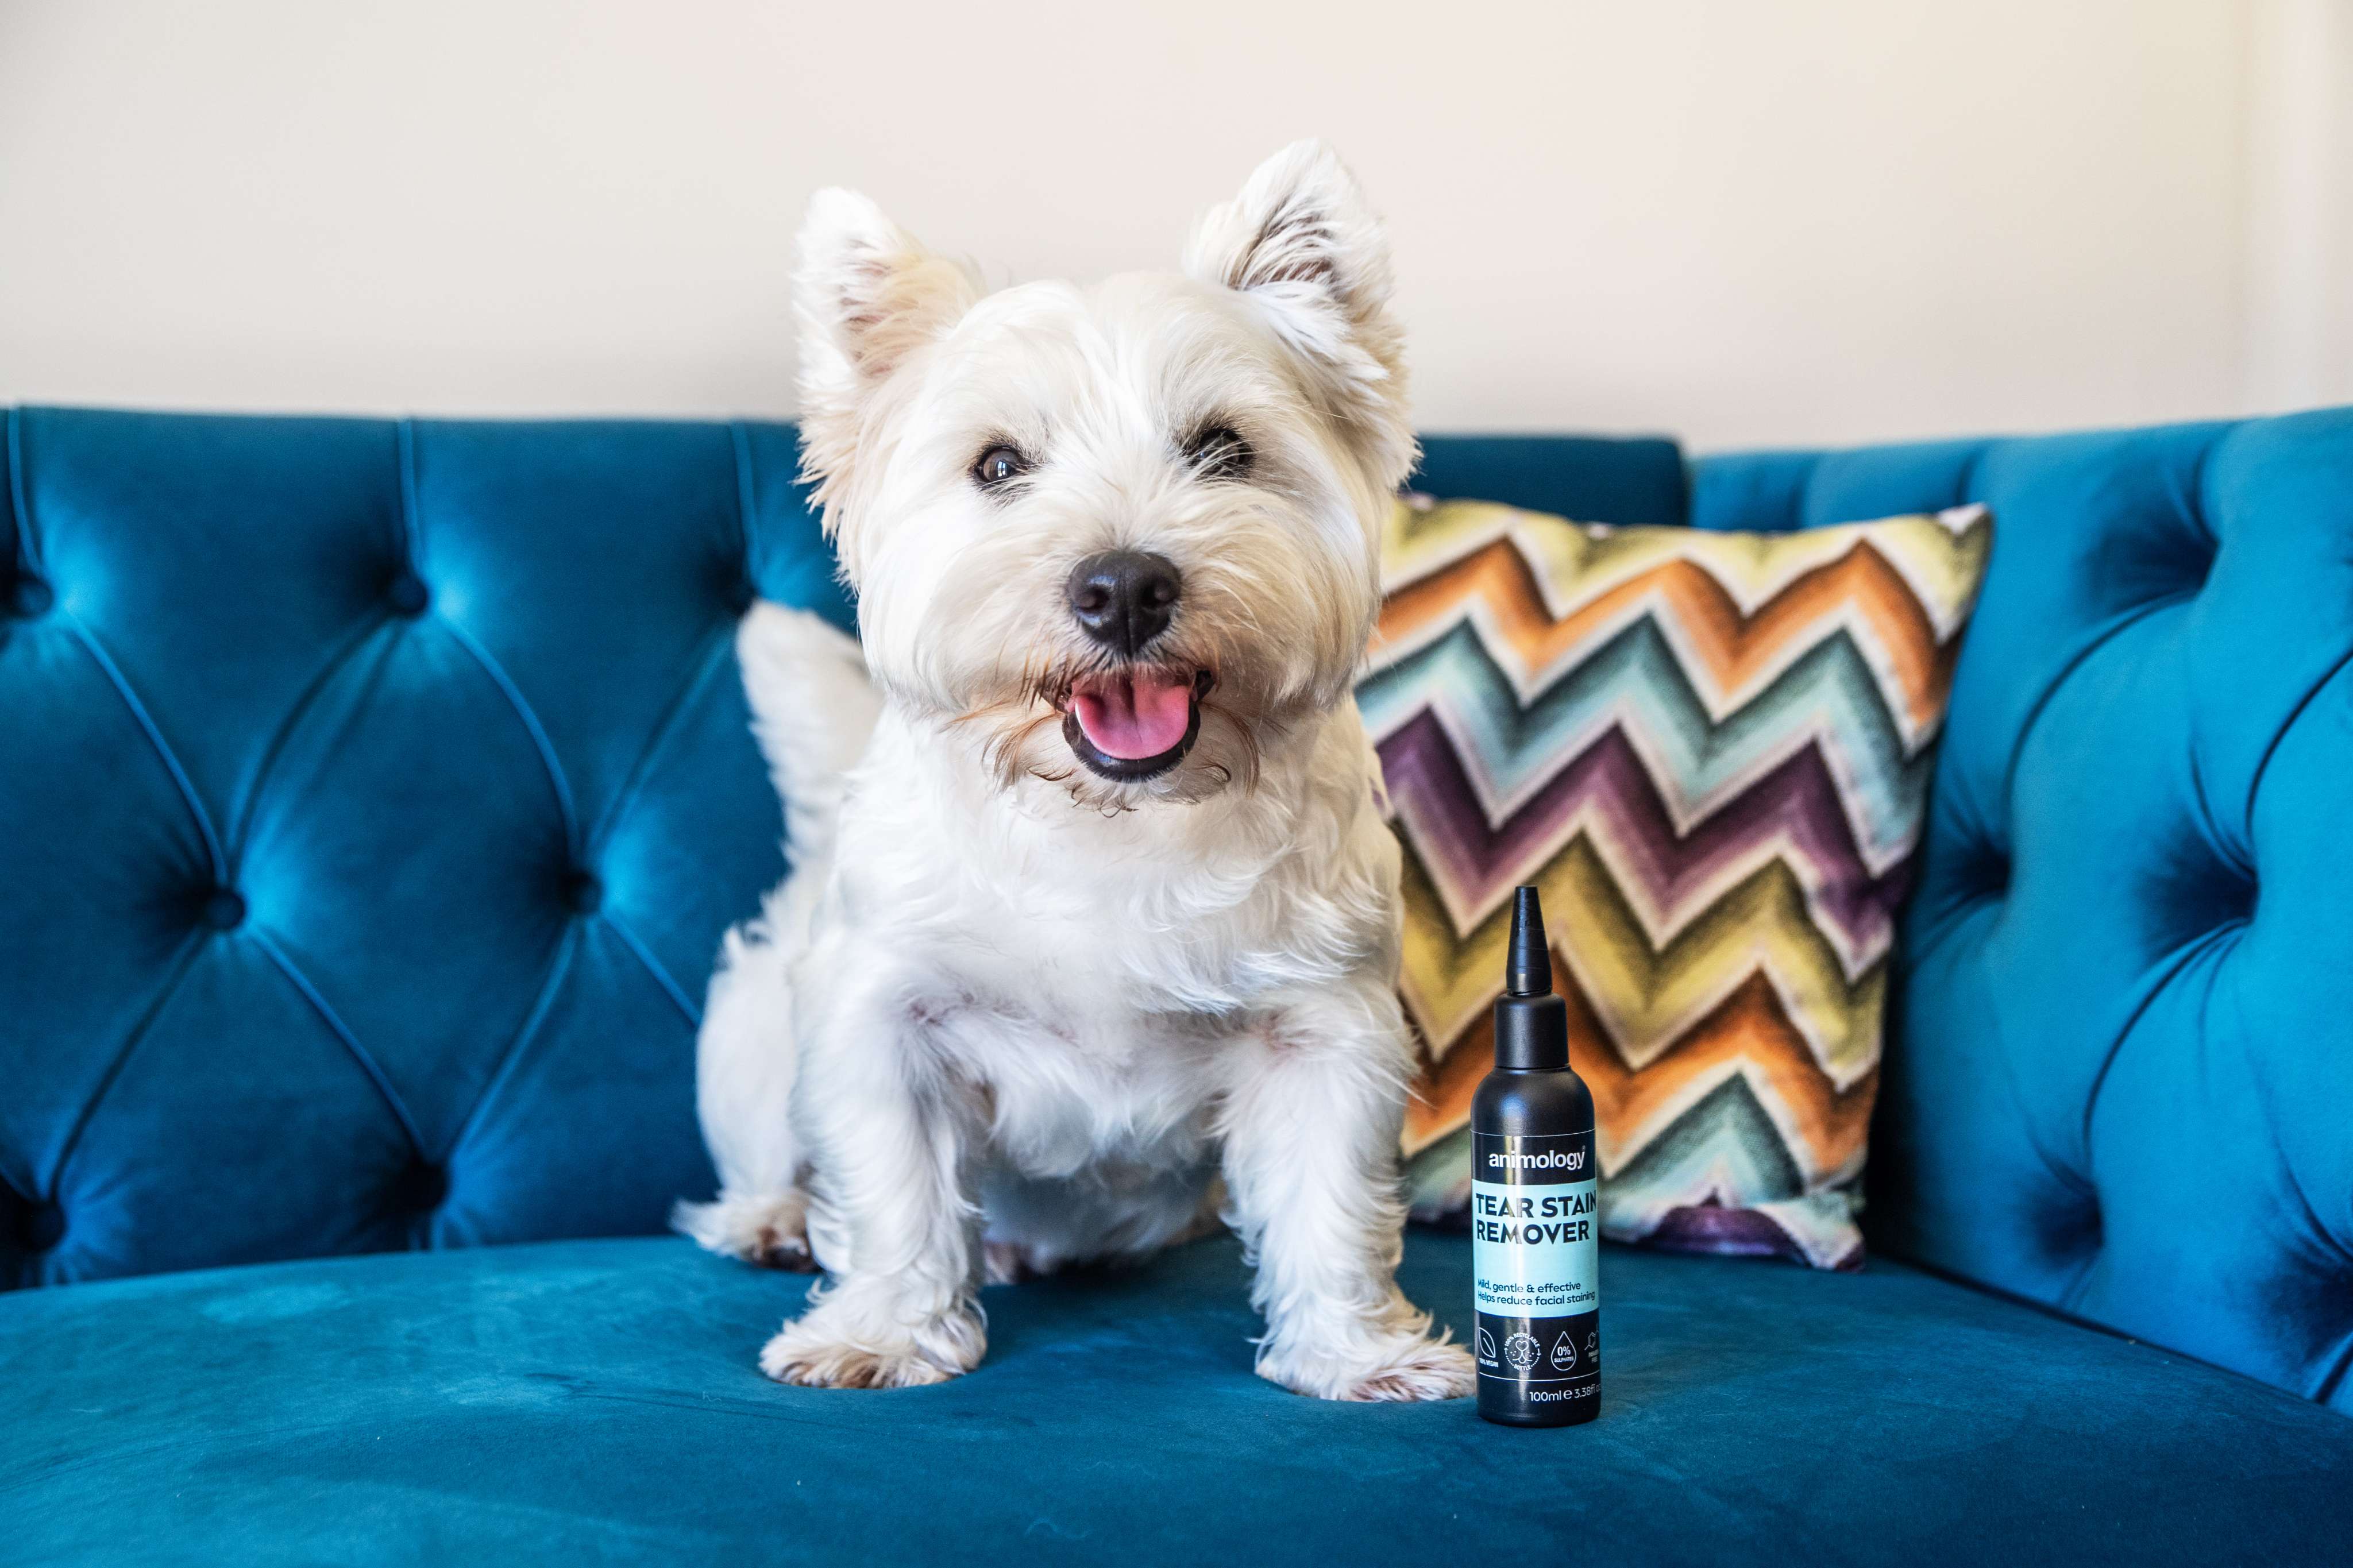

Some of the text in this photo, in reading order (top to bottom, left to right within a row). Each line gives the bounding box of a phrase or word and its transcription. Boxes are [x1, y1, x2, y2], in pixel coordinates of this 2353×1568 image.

[1488, 1150, 1585, 1171] animology
[1476, 1190, 1596, 1218] TEAR STAIN
[1476, 1219, 1590, 1245] REMOVER
[1478, 1279, 1581, 1293] Mild, gentle & effective
[1478, 1291, 1595, 1306] Helps reduce facial staining
[1557, 1346, 1571, 1356] 0%
[1529, 1390, 1561, 1401] 100ml
